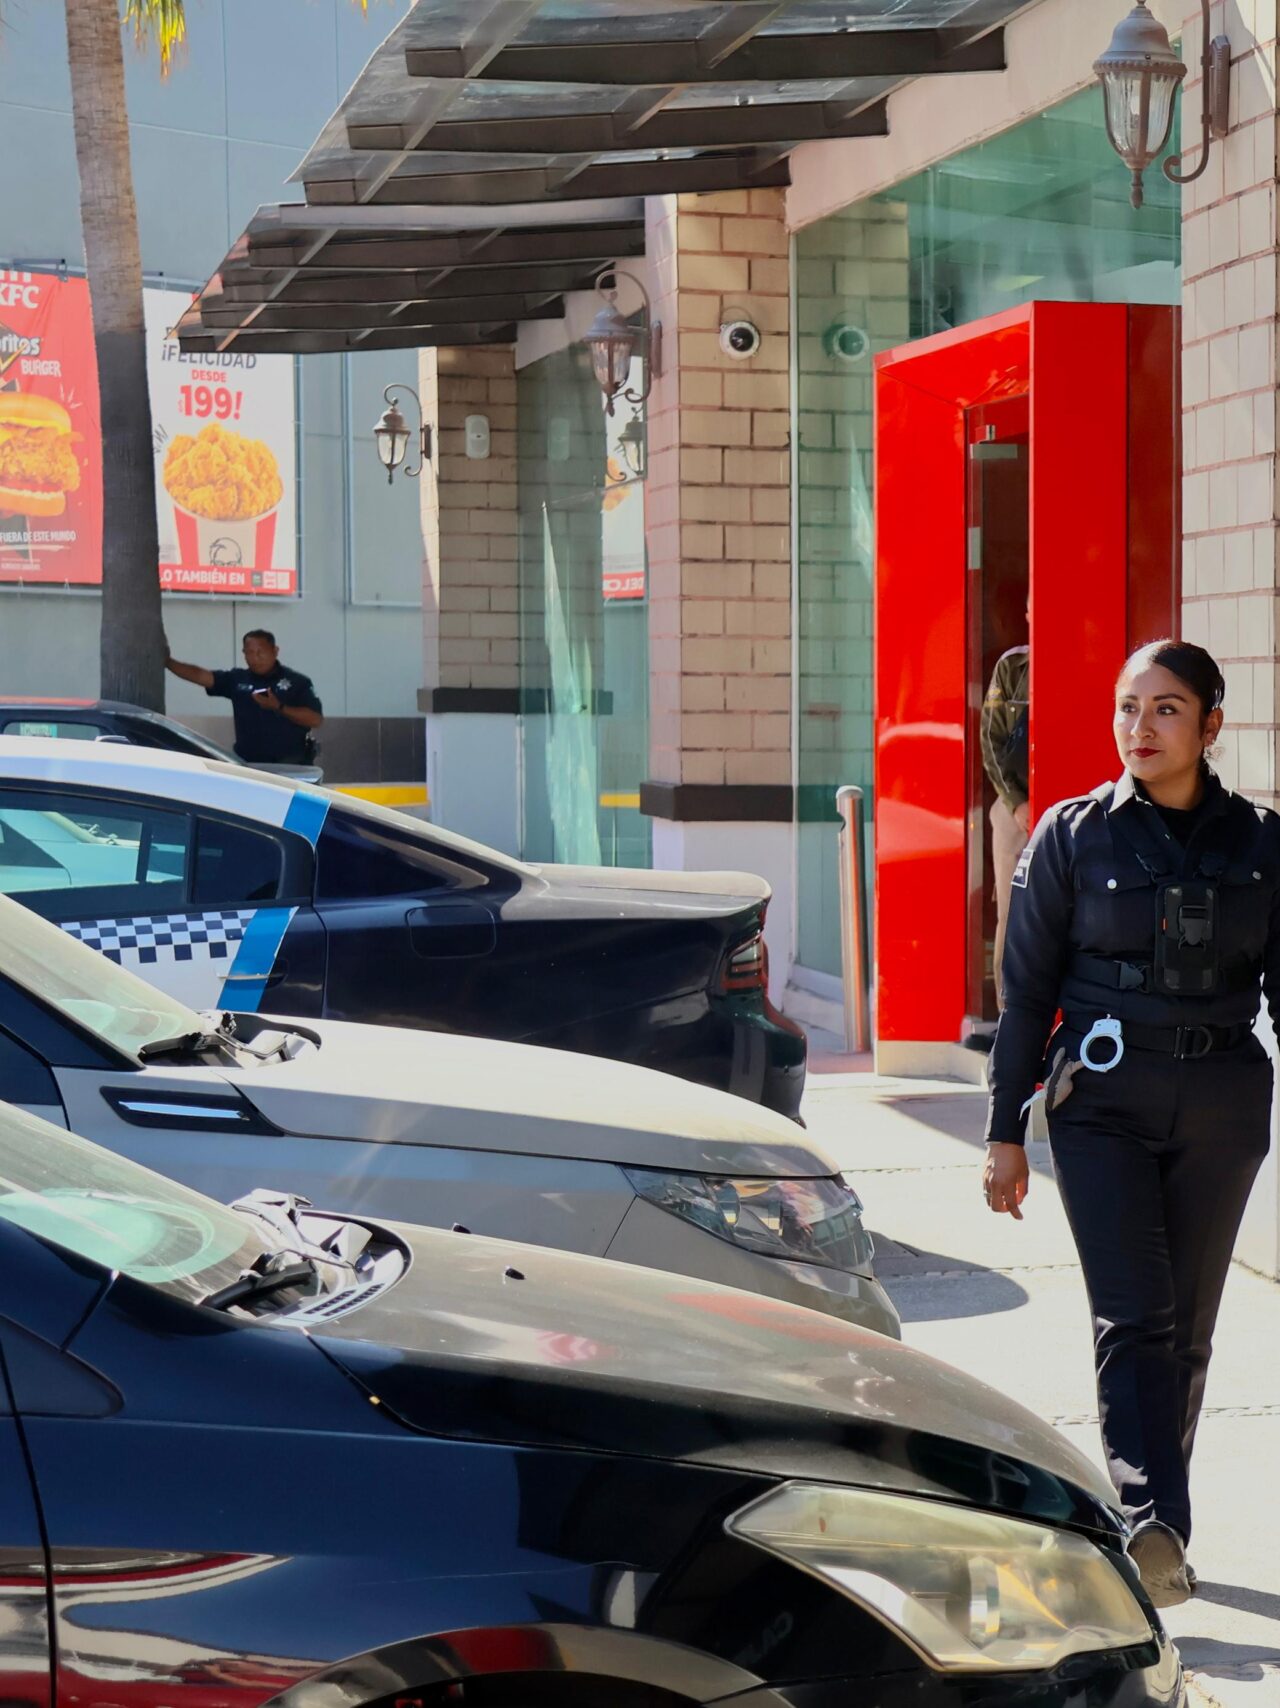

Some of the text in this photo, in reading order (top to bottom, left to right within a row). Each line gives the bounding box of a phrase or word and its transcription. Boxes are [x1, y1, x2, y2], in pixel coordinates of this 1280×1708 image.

[20, 358, 62, 377] BURGER
[192, 369, 227, 382] DESDE
[180, 385, 243, 420] 199!
[175, 566, 227, 585] TAMBIÉN
[229, 572, 245, 586] EN
